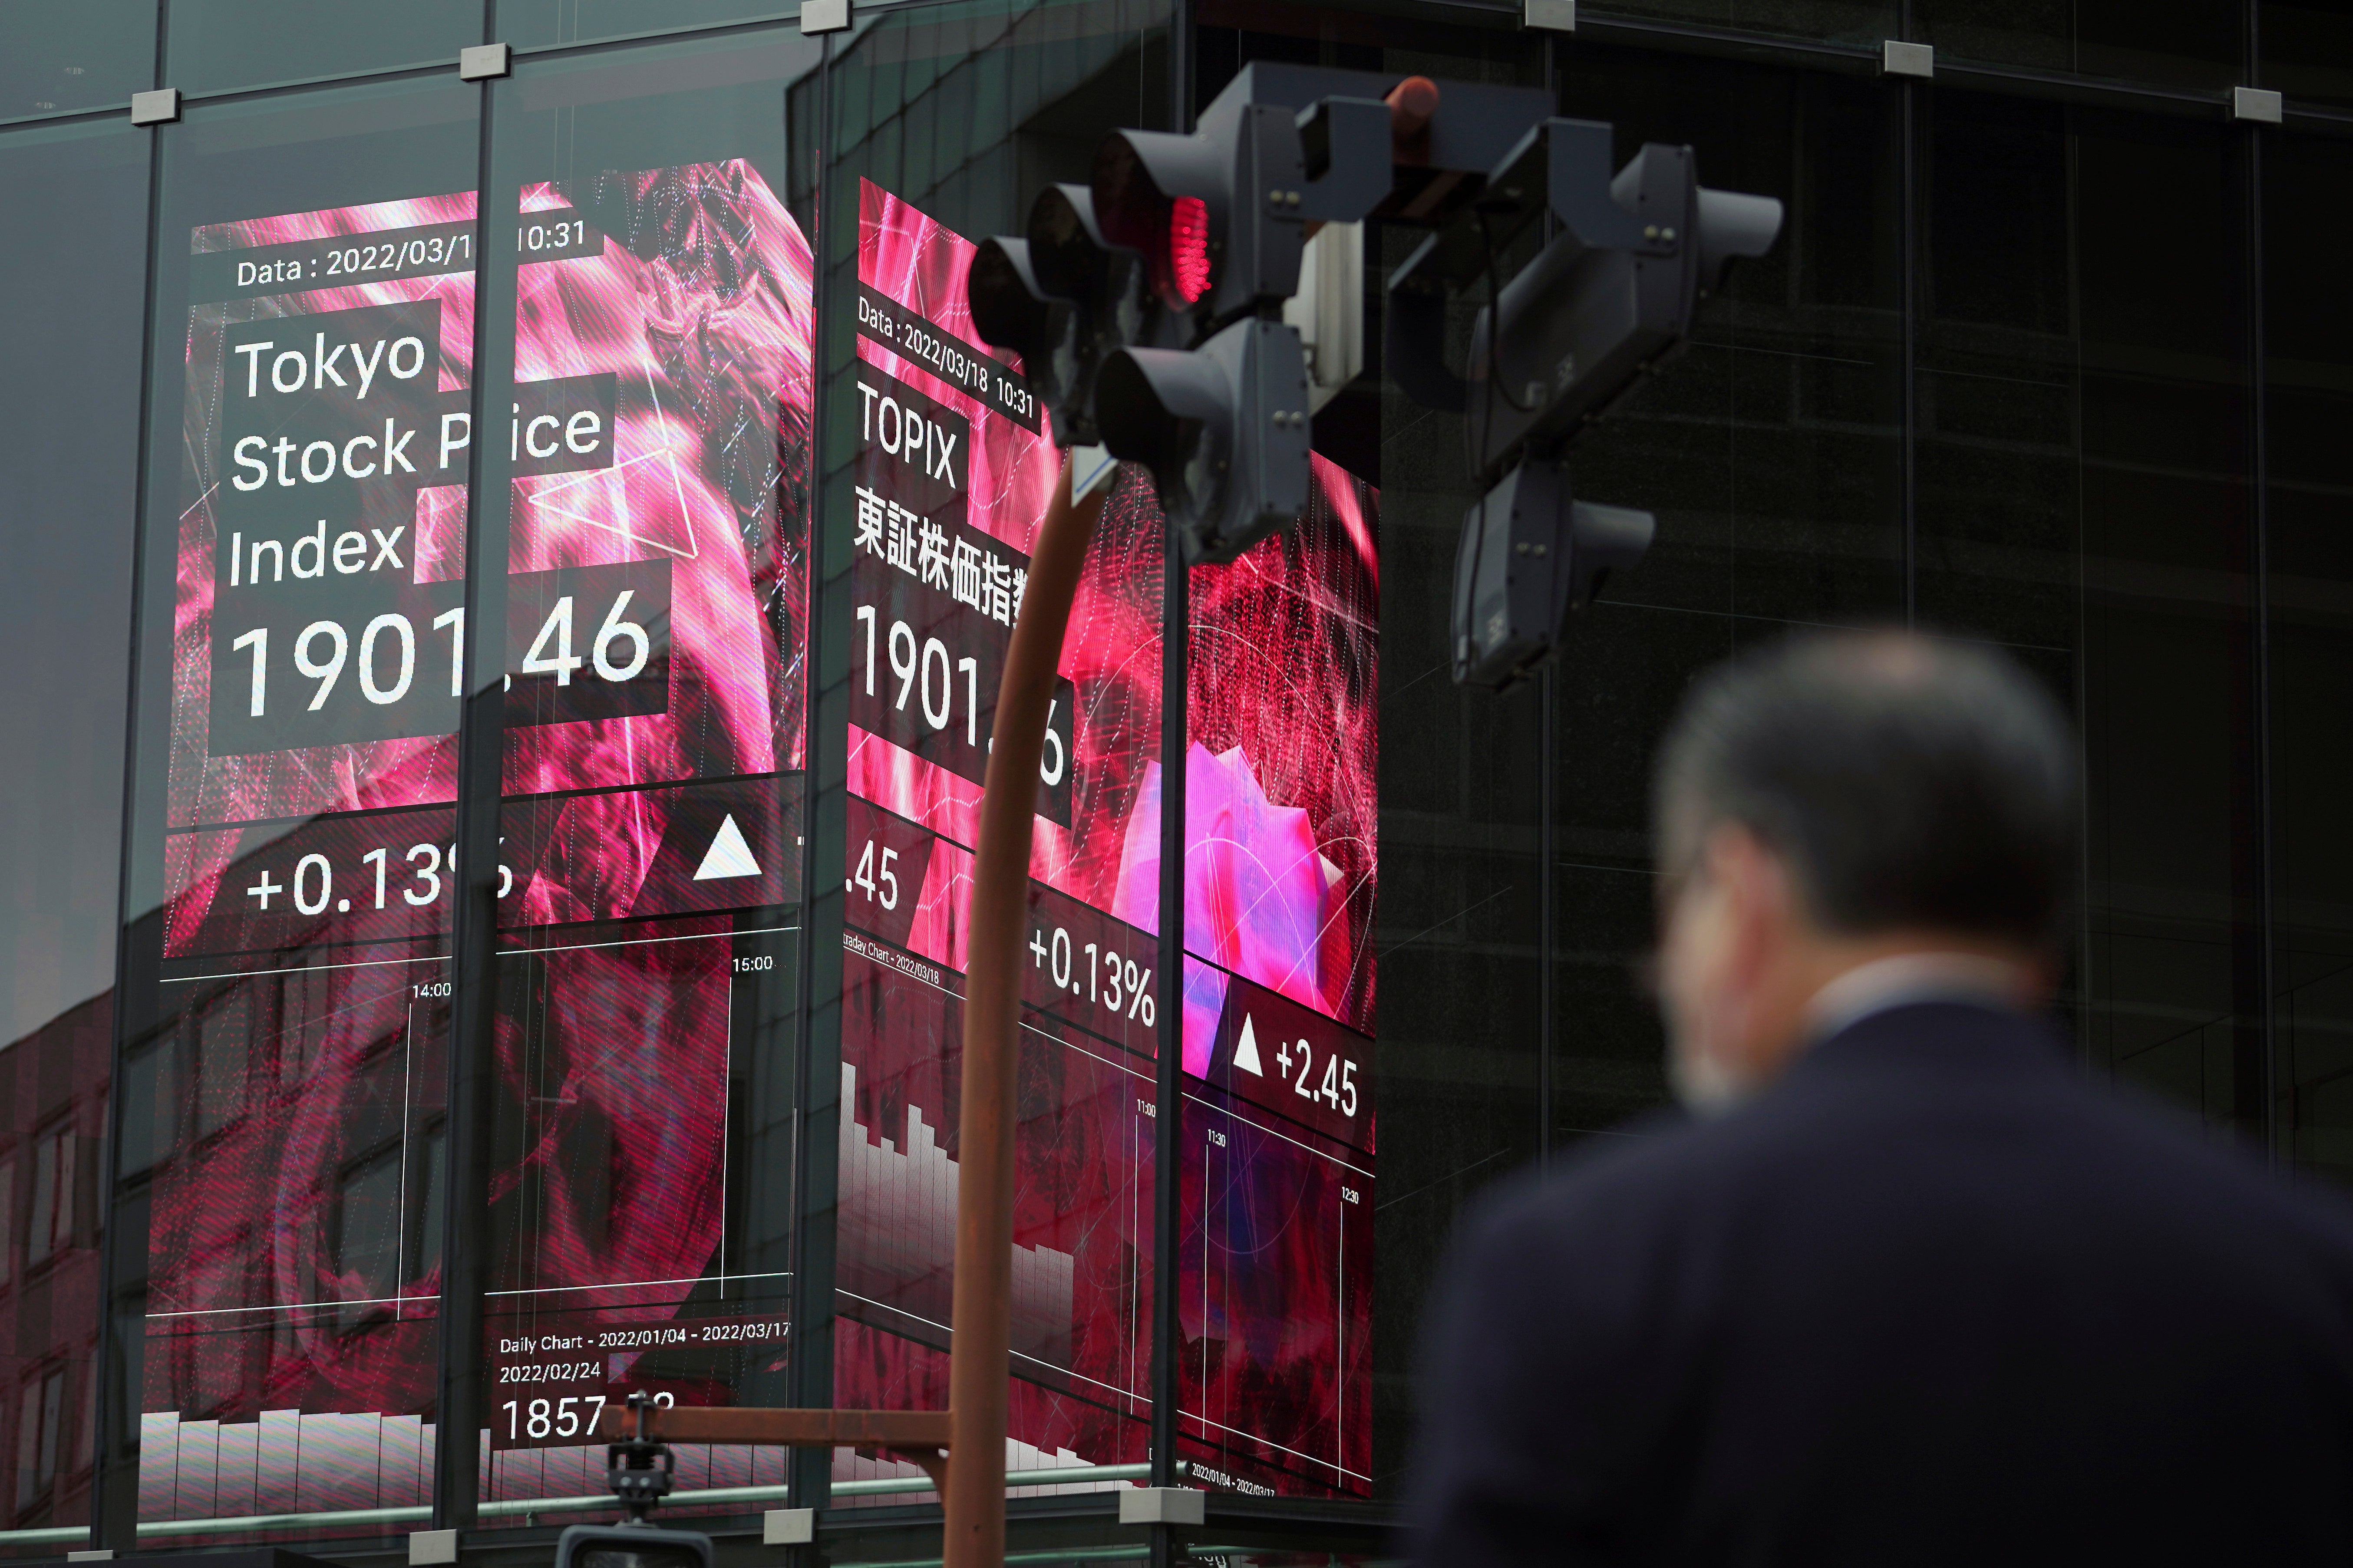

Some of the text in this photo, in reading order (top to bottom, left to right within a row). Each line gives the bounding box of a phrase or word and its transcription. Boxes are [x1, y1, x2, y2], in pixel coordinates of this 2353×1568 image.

[238, 258, 302, 286] Data
[327, 234, 470, 276] 2022/03/1
[518, 220, 584, 250] 10:31
[235, 332, 425, 400] Tokyo
[858, 296, 893, 338] Data
[904, 324, 988, 392] 2022/03/18
[997, 377, 1033, 419] 10:31
[232, 402, 601, 491] Stock Pice
[857, 380, 957, 489] TOPIX
[231, 520, 405, 586] Index
[857, 605, 1064, 786] 1901.6
[247, 837, 513, 916] +0.13
[413, 982, 451, 998] 14:00
[733, 956, 772, 972] 15:00
[868, 942, 889, 963] Chart
[896, 954, 940, 985] 2022/03/18
[1030, 927, 1155, 1027] +0.13%
[1277, 1038, 1357, 1117] +2.45
[1137, 1099, 1156, 1117] 11:00
[1208, 1129, 1226, 1147] 11:30
[1342, 1186, 1359, 1205] 12:30
[500, 1337, 537, 1355] Daily
[541, 1335, 583, 1350] Chart
[598, 1328, 686, 1347] 2022/01/04
[702, 1322, 791, 1341] 2022/03/17
[500, 1361, 601, 1383] 2022/02/24
[502, 1391, 674, 1440] 1857
[1192, 1463, 1230, 1487] 2022/01/04
[1237, 1478, 1275, 1497] 2022/03/17
